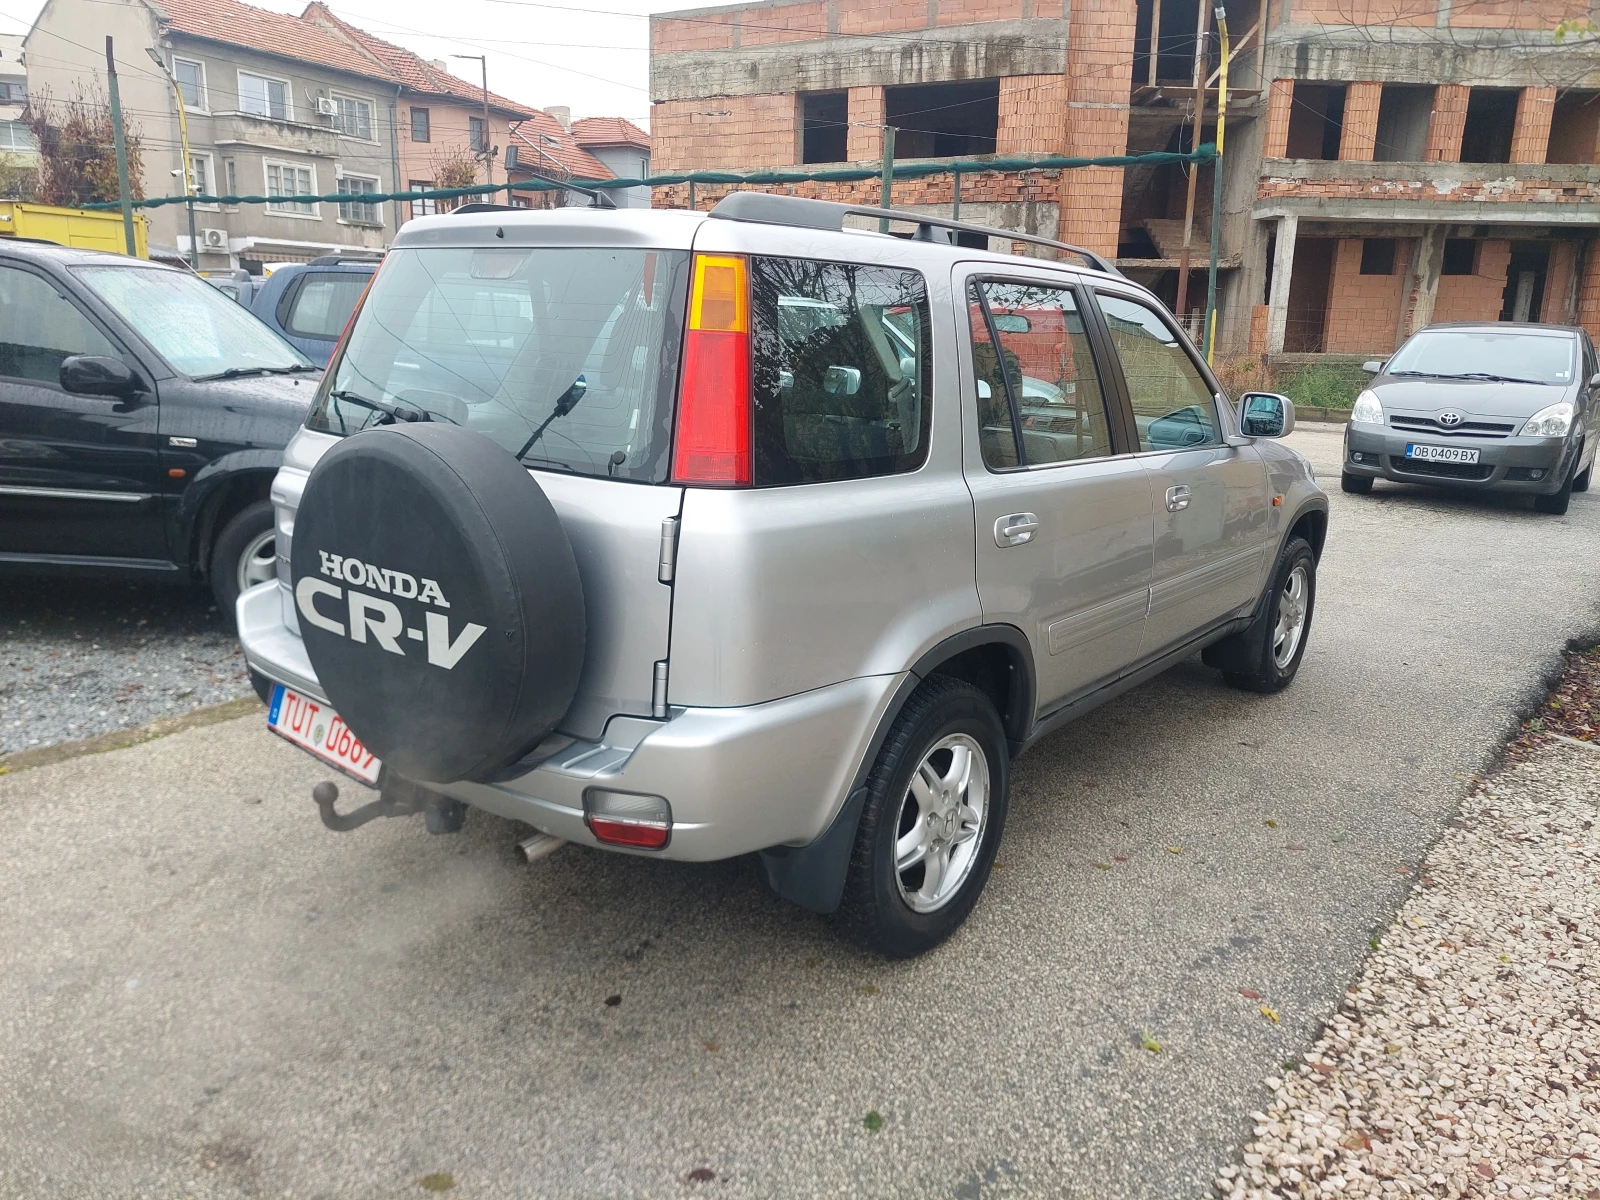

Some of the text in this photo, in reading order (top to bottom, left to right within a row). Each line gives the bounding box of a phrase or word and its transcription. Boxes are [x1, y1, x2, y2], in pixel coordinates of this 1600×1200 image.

[1414, 446, 1429, 457] OB
[1431, 448, 1459, 460] 0409
[1460, 450, 1477, 462] BX
[318, 549, 450, 608] HONDA
[295, 576, 488, 670] CR-V
[284, 692, 320, 739] TUT
